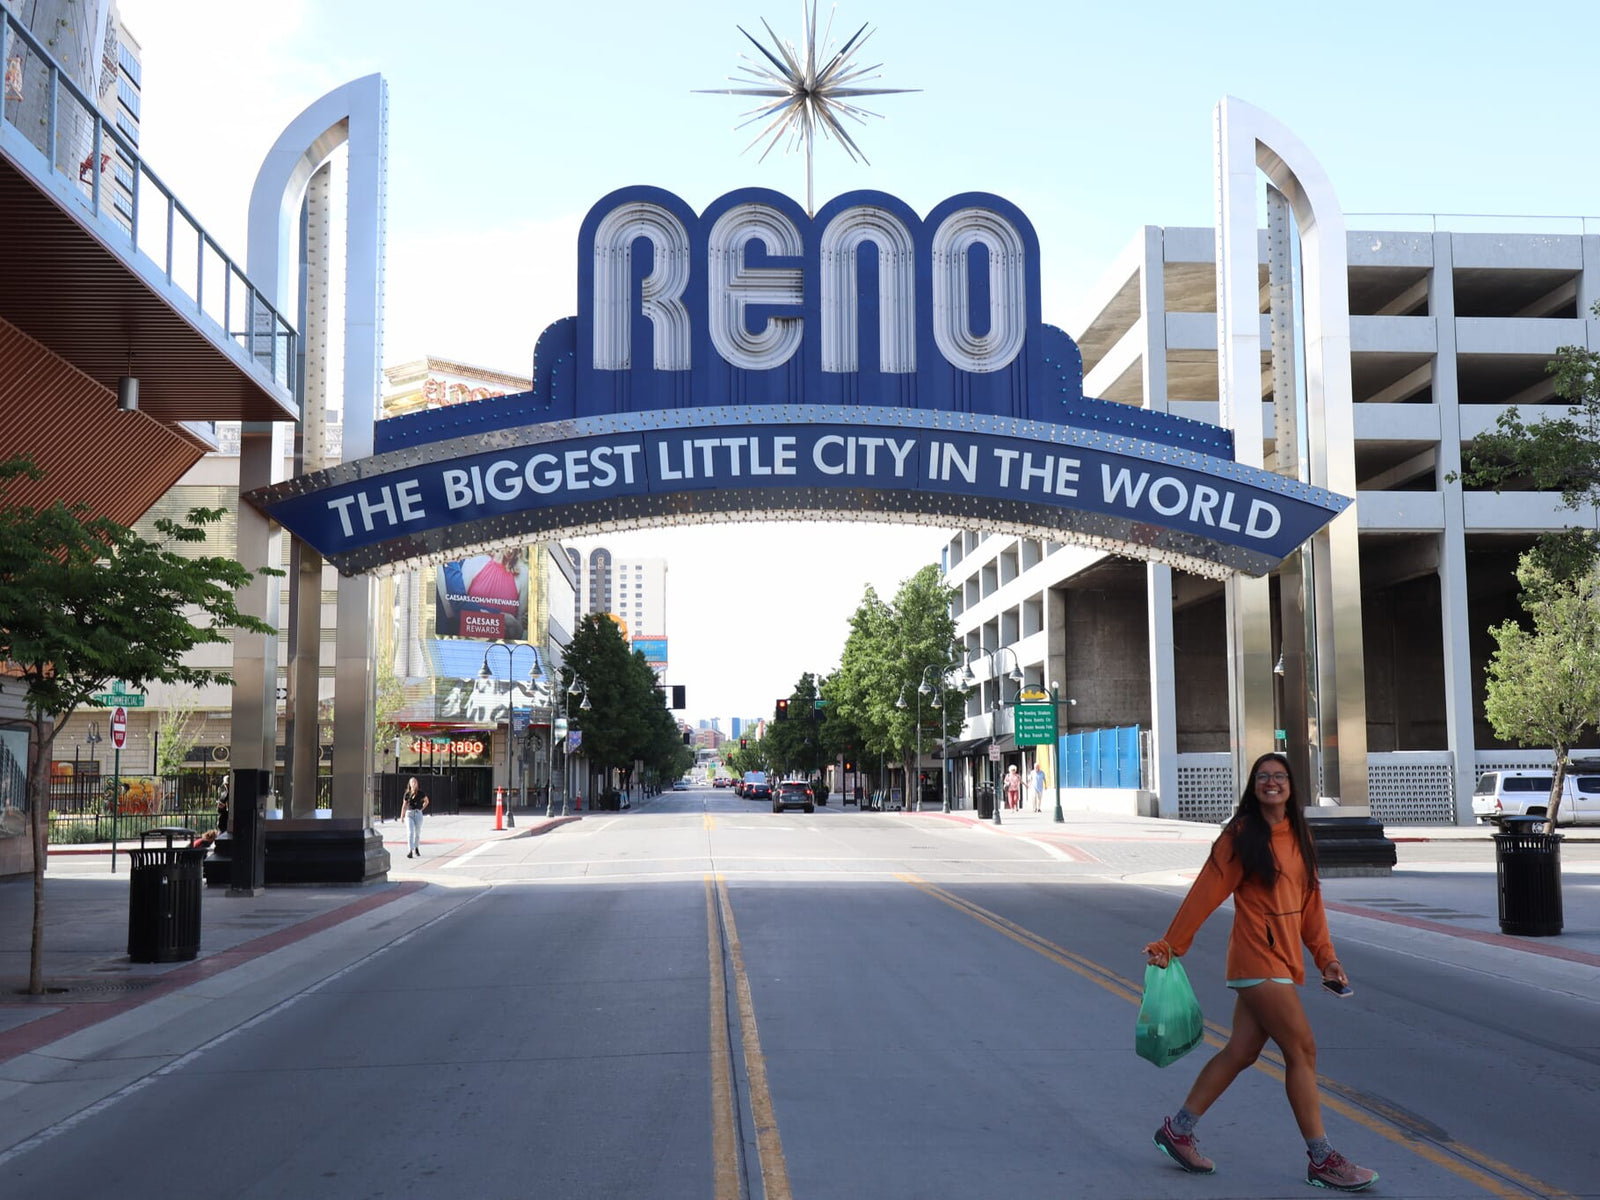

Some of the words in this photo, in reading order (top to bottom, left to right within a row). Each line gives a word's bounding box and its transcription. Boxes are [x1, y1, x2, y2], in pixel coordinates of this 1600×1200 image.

[593, 201, 1026, 373] RENO
[328, 479, 426, 537] THE
[443, 444, 641, 510] BIGGEST
[658, 436, 797, 481] LITTLE
[812, 435, 916, 477] CITY
[928, 441, 978, 484] IN
[993, 448, 1081, 497] THE
[1101, 463, 1282, 540] WORLD
[445, 594, 520, 607] CAESARS.COM/MYREWARDS
[466, 616, 500, 627] CAESARS
[466, 625, 500, 635] REWARDS
[108, 696, 137, 705] COMMERCIAL
